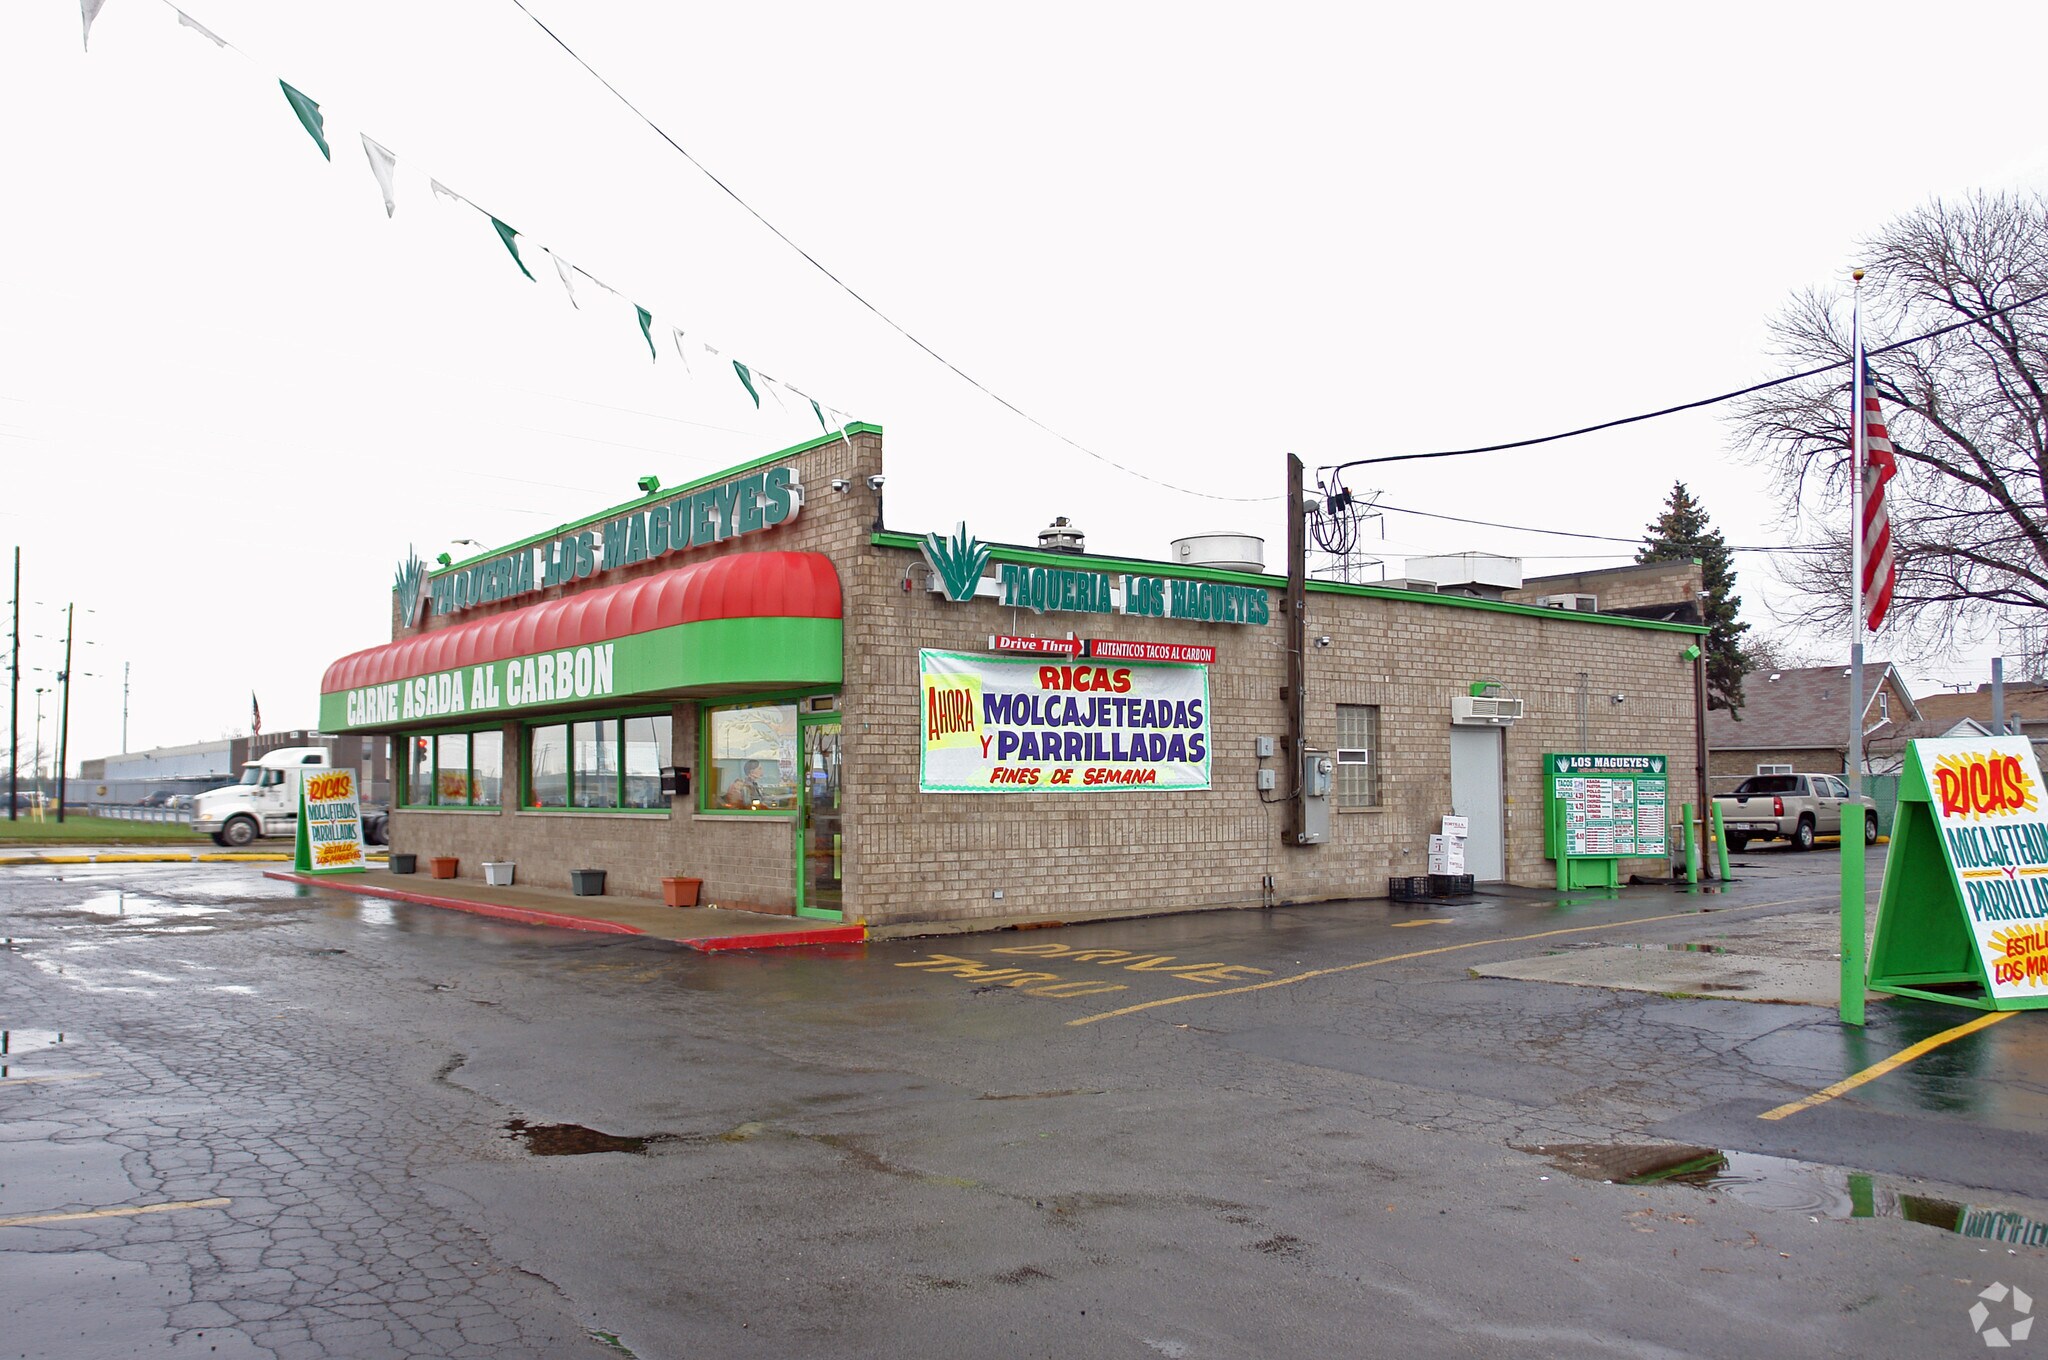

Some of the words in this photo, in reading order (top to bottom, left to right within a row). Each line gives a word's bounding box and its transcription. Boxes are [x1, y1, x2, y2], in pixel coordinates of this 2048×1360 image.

[430, 548, 540, 616] TAQUERIA
[545, 531, 602, 586] LOS
[602, 467, 799, 571] MAGUEYES
[1000, 563, 1112, 613] TAQUERIA
[1123, 574, 1164, 617] LOS
[1168, 580, 1270, 625] MAGUEYES
[999, 636, 1038, 651] Drive
[1041, 639, 1073, 653] Thru
[1096, 642, 1145, 657] AUTENTICOS
[1146, 645, 1170, 659] TACOS
[1171, 646, 1181, 659] AL
[1181, 647, 1212, 661] CARBON
[347, 680, 398, 727] CARNE
[403, 670, 465, 718] ASADA
[471, 664, 499, 710] AL
[506, 643, 614, 705] CARBON
[1039, 665, 1132, 693] RICAS
[928, 686, 976, 742] AHORA
[983, 693, 1204, 729] MOLCAJETEADAS
[980, 735, 993, 760] Y
[998, 730, 1206, 763] PARRILLADAS
[1571, 757, 1591, 767] LOS
[1594, 757, 1649, 768] MAGUEYES
[309, 775, 352, 803] RICAS
[990, 767, 1040, 785] FINES
[1051, 768, 1074, 785] DE
[1083, 768, 1156, 785] SEMANA
[1557, 779, 1573, 787] TACOS
[1936, 755, 2026, 818] RICAS
[307, 802, 358, 821] MOCAJETEADAS
[311, 823, 358, 842] PARRILLADAS
[316, 853, 331, 865] LOS
[330, 850, 362, 864] MAGUEYES
[323, 843, 352, 855] ESTILLO
[2002, 866, 2017, 880] Y
[893, 954, 1130, 998] THRU
[990, 943, 1275, 984] DRIVE
[1995, 961, 2025, 985] LOS
